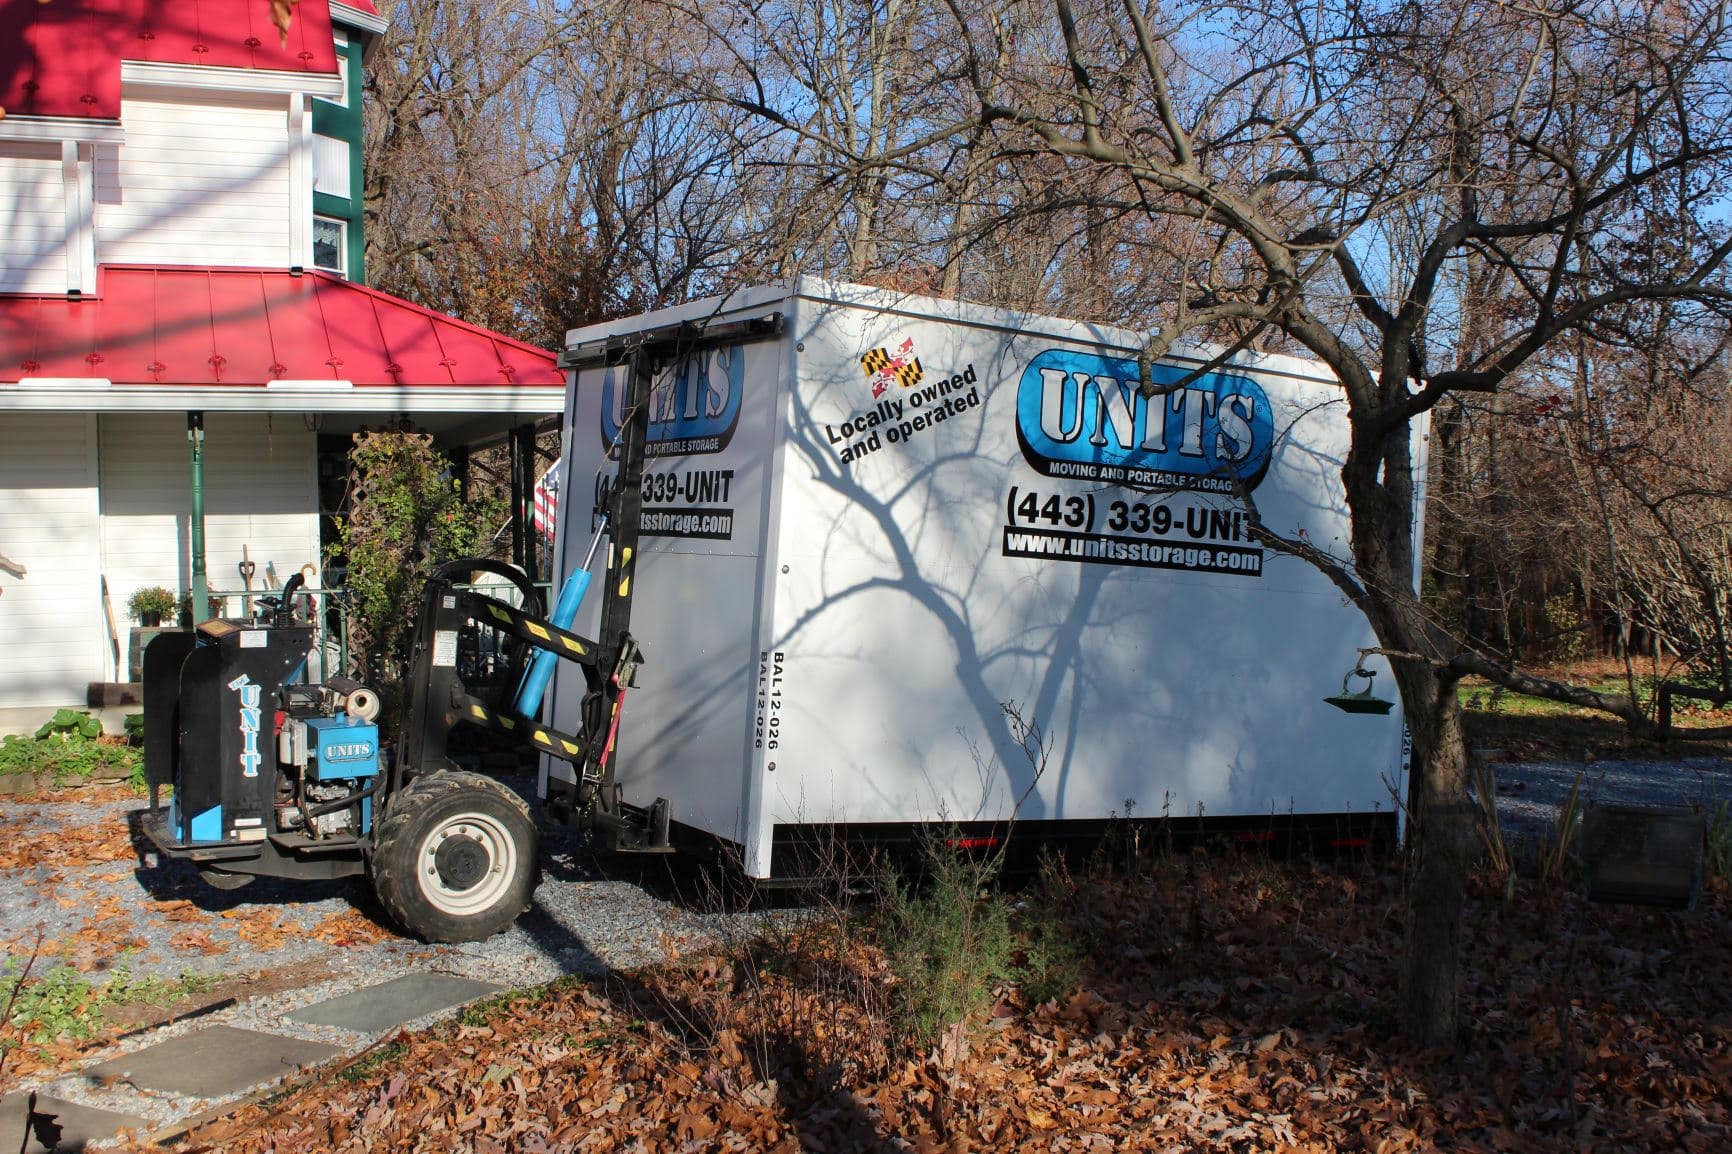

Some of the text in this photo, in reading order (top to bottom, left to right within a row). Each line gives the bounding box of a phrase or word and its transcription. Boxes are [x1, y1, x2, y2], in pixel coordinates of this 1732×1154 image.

[826, 364, 977, 444] Locally owned
[841, 387, 980, 465] and operated
[1039, 368, 1254, 460] UNITS
[653, 440, 686, 455] PORTABLE
[687, 438, 719, 452] STORAGE
[1050, 461, 1097, 478] MOVING
[1101, 468, 1125, 481] AND
[1127, 471, 1185, 486] PORTABLE
[643, 470, 734, 503] 339-UNIT
[1007, 486, 1095, 532] (443)
[1007, 533, 1260, 571] www.unitsstorage.com
[239, 684, 262, 777] UNIT
[755, 651, 768, 749] BAL12-026
[768, 652, 785, 750] BAL12-026
[327, 744, 370, 757] UNITS
